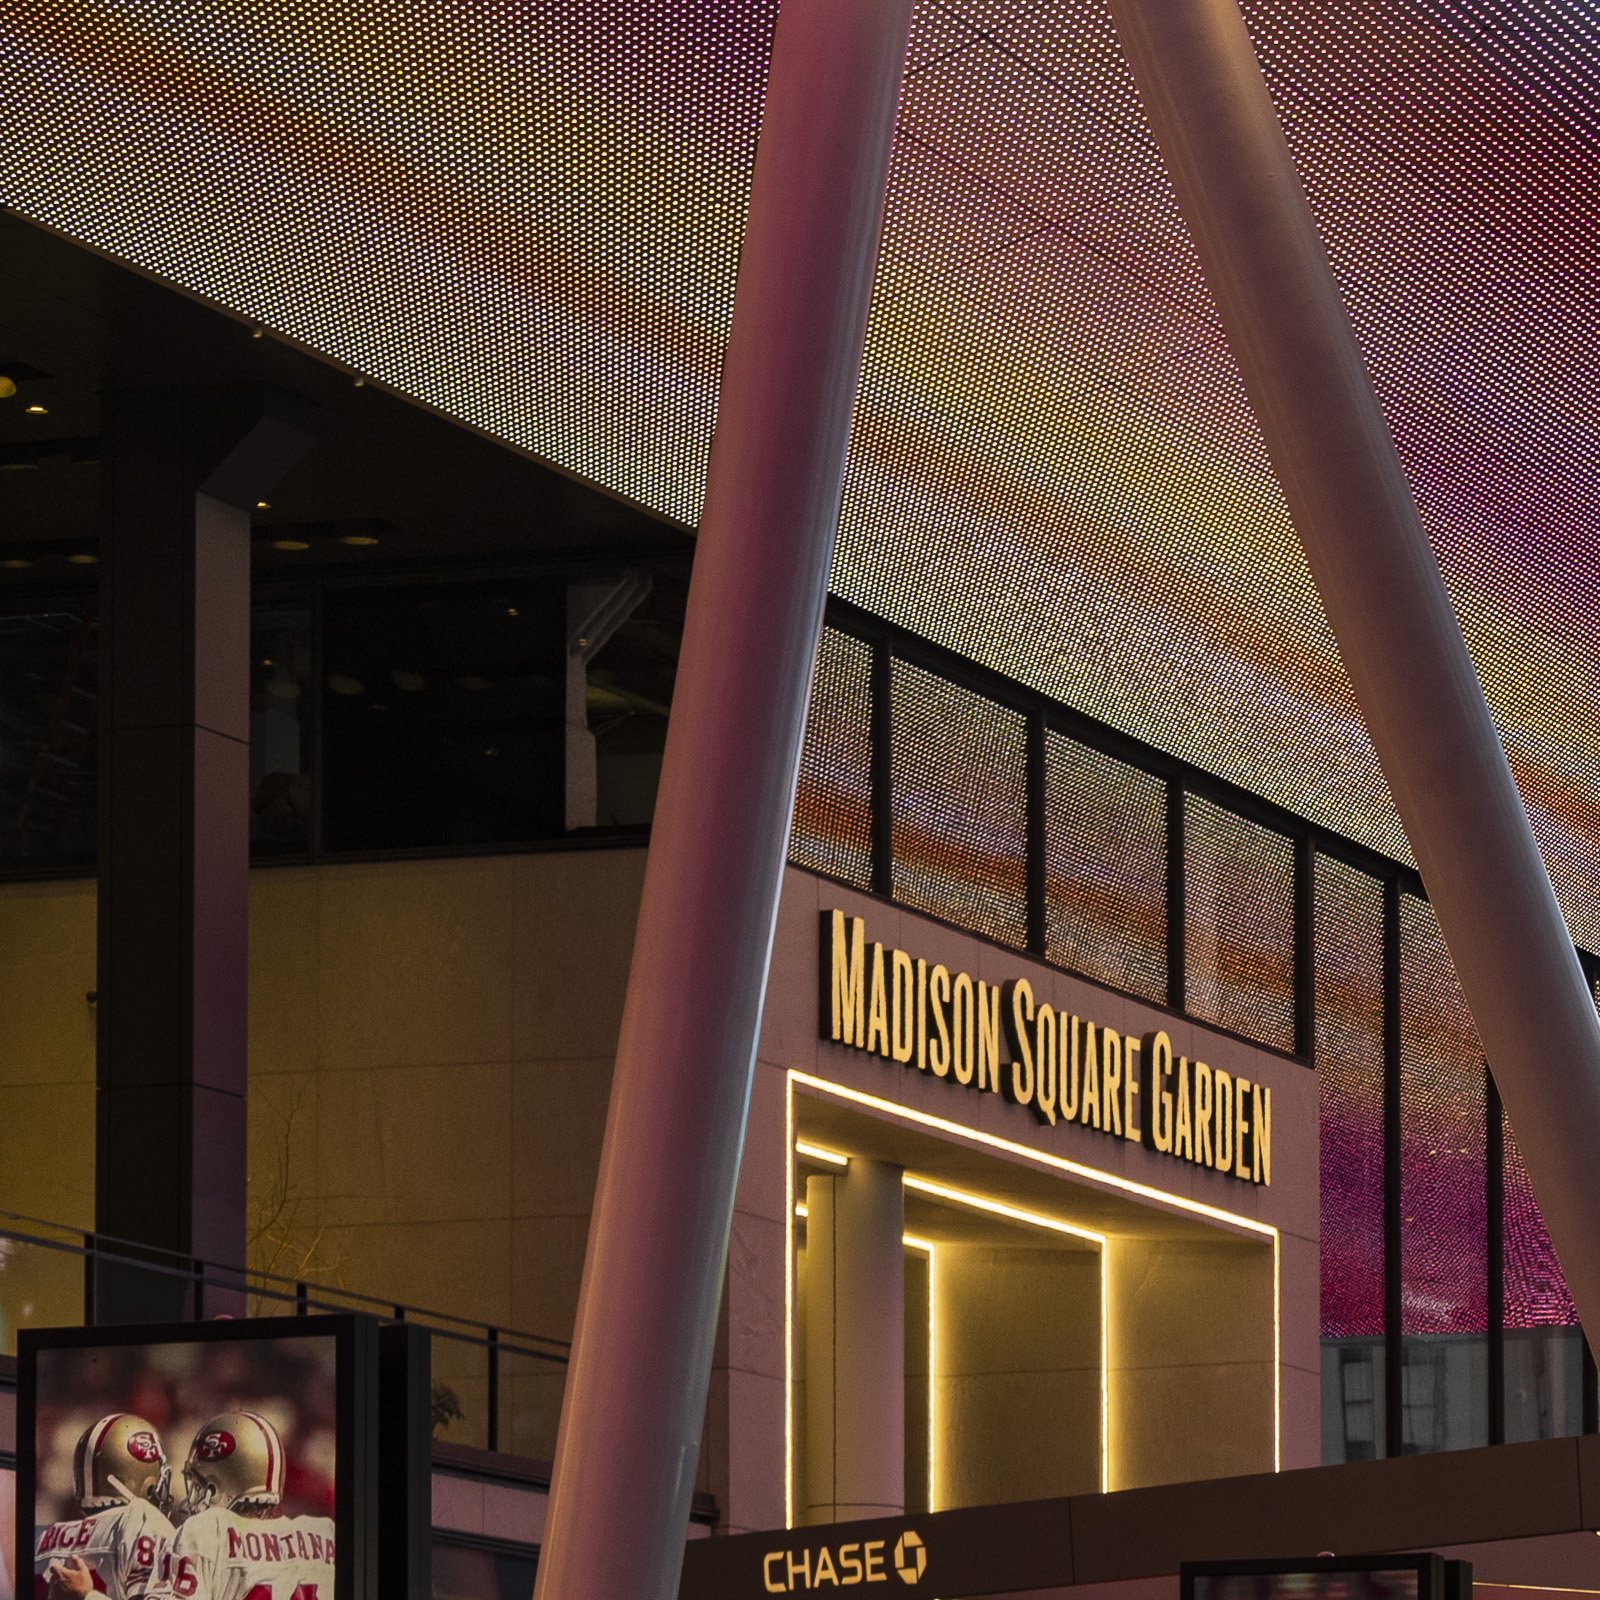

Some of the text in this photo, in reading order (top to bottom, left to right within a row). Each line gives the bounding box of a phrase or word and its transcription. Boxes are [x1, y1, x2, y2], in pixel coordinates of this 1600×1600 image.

[831, 909, 1272, 1187] MADISON SQUARE GARDEN
[38, 1518, 97, 1553] RICE
[227, 1527, 335, 1565] MONTANA
[763, 1540, 888, 1594] CHASE
